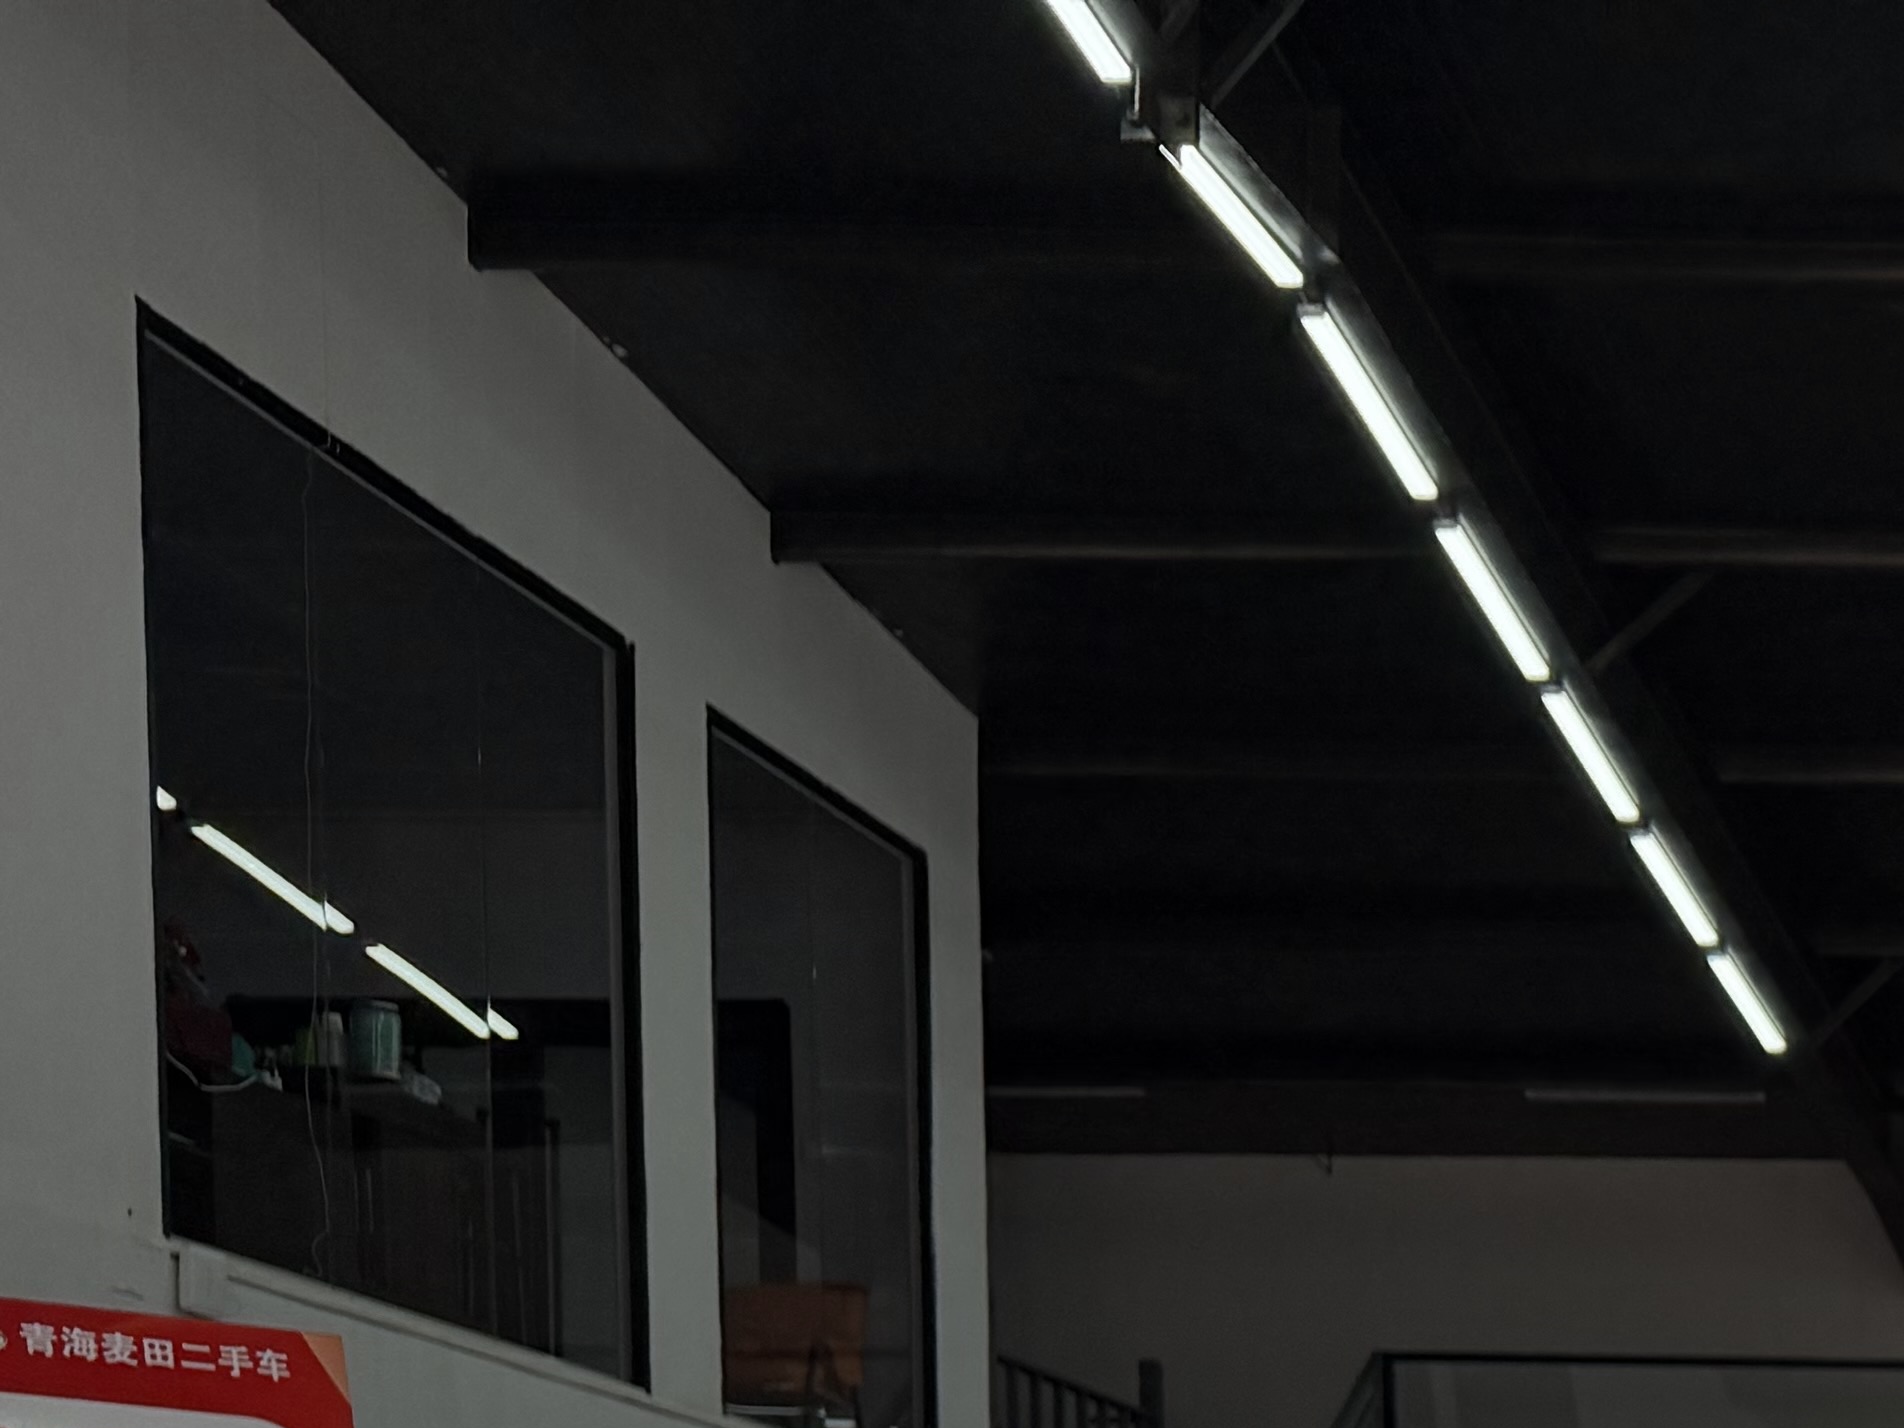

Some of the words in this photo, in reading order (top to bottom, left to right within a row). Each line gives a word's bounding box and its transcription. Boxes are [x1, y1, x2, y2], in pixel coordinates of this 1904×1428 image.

[19, 1321, 291, 1383] 青海麦田二手车
